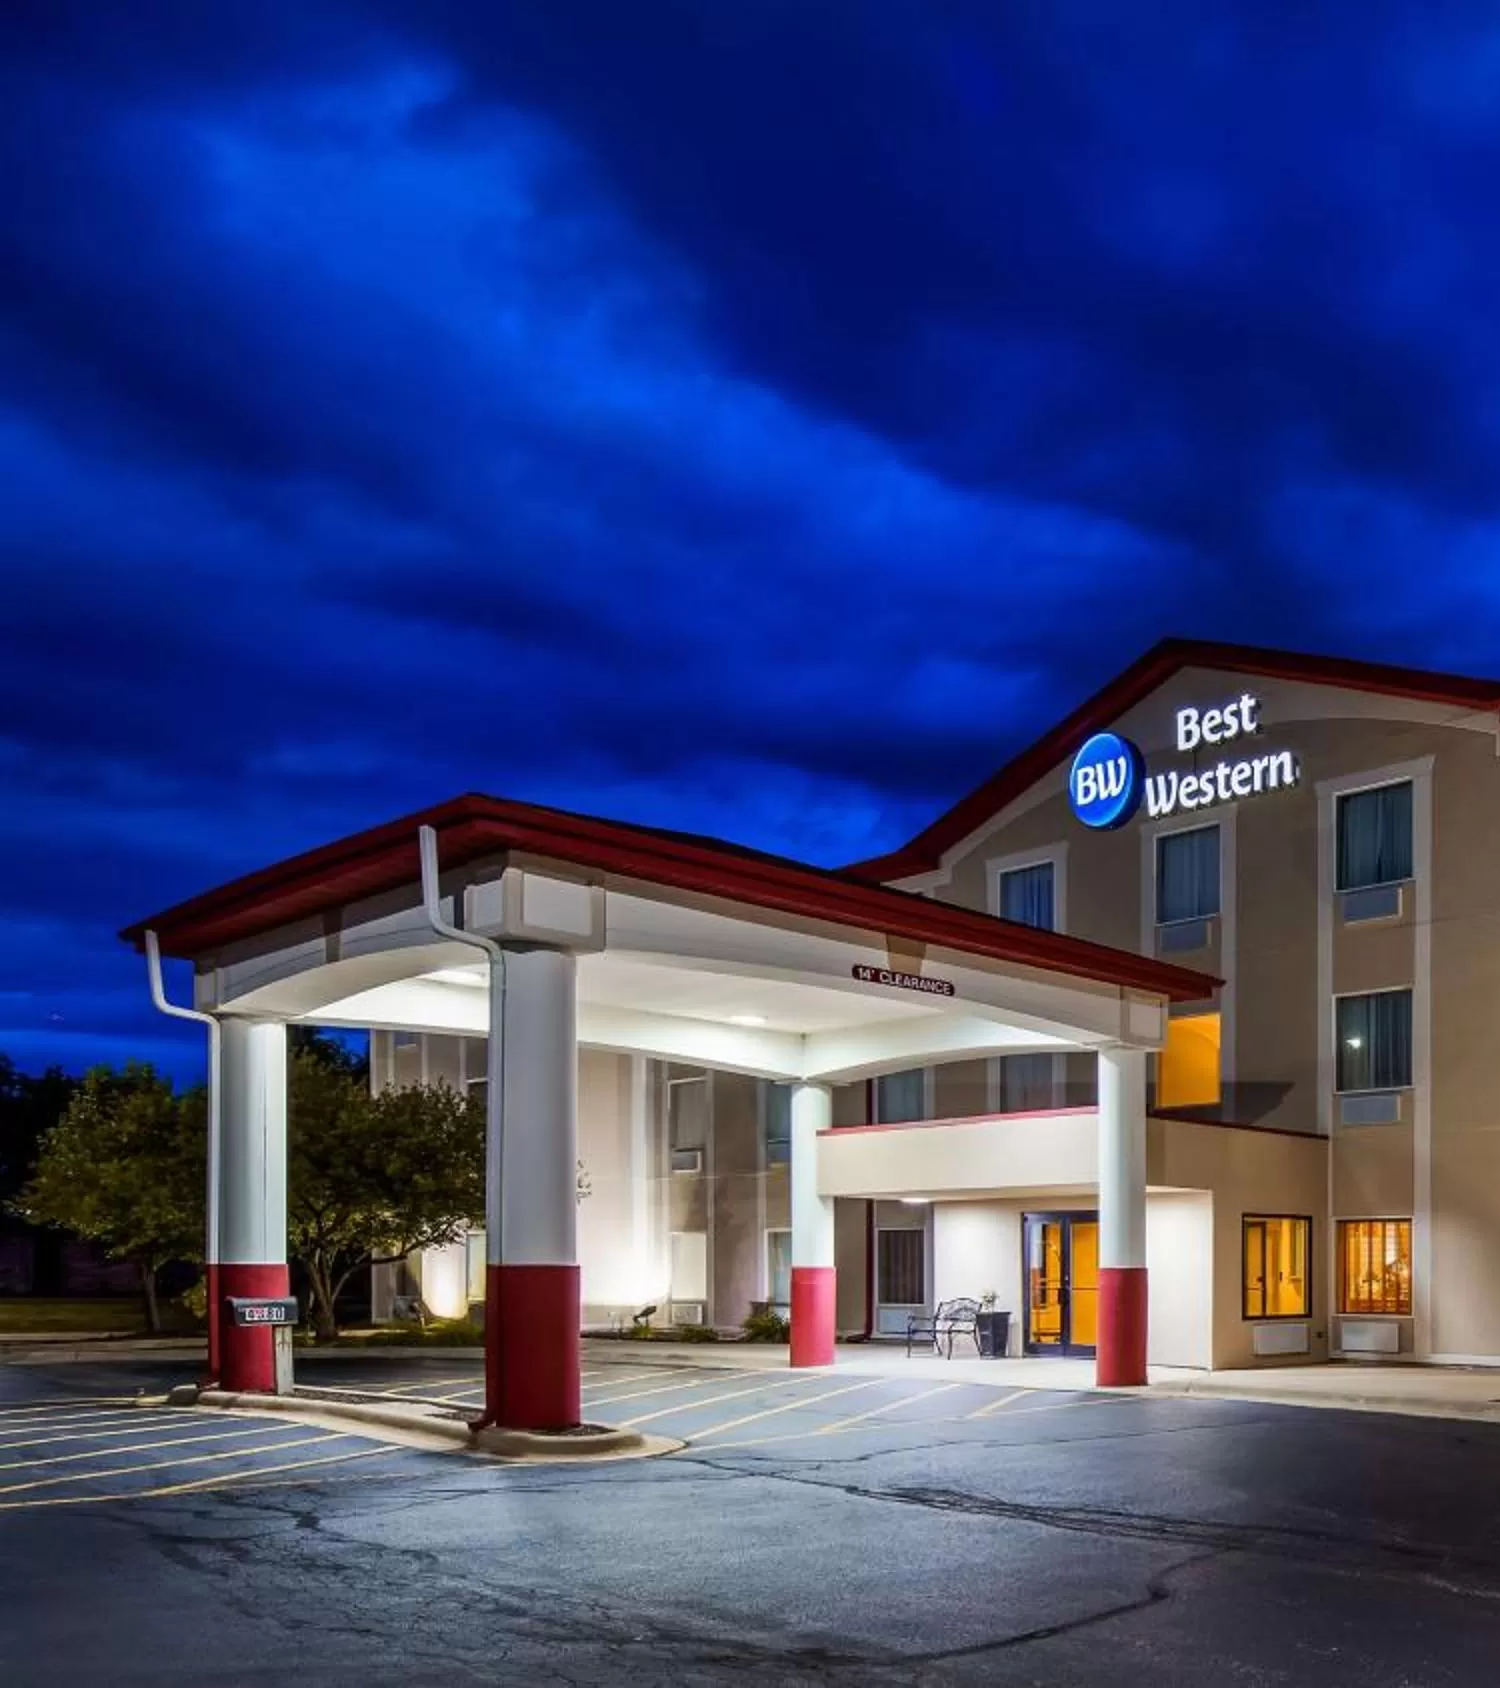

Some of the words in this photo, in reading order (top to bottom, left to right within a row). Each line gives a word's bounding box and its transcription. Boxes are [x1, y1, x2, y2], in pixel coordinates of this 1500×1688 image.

[1176, 693, 1257, 751] Best
[1076, 756, 1127, 805] BW
[1145, 751, 1294, 816] Western
[880, 971, 952, 995] CLEARANCE
